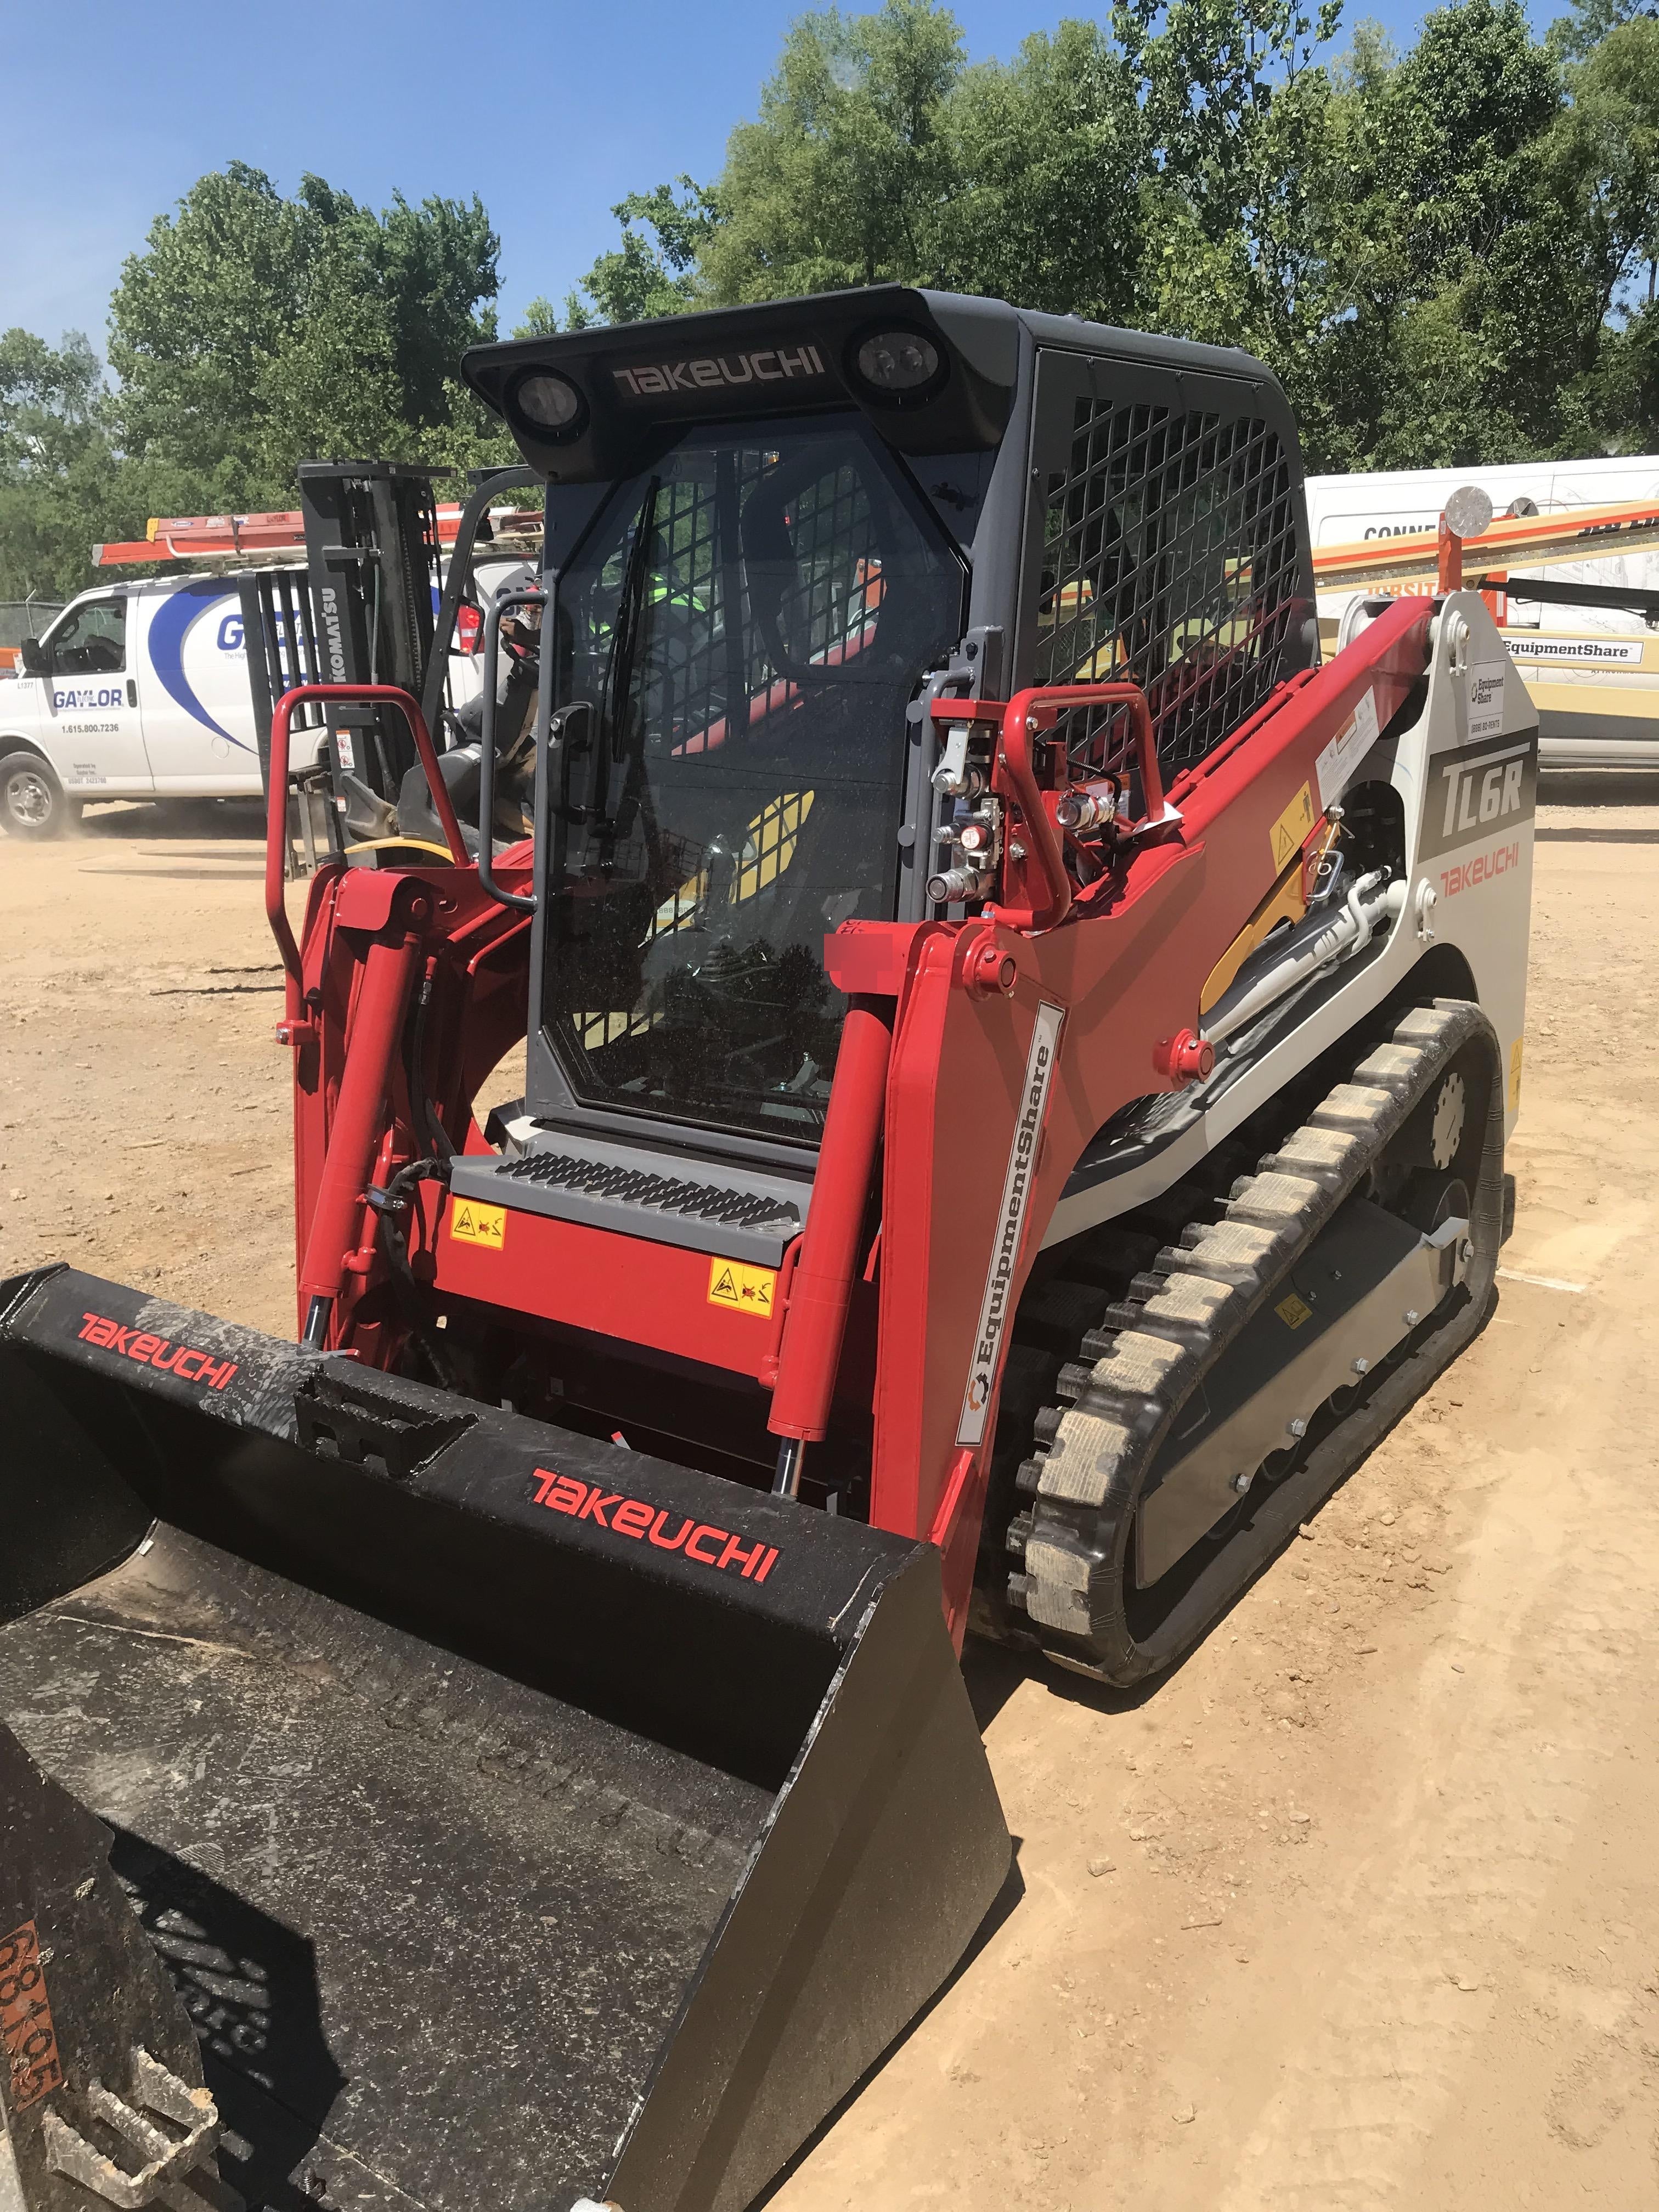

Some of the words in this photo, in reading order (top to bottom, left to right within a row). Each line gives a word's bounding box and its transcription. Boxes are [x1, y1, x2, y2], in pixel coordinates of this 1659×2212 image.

[612, 346, 825, 394] TAKEUCHI
[321, 588, 346, 682] KOMATSU
[1503, 641, 1629, 658] EquipmentShare
[53, 689, 122, 708] GAYLOR
[1477, 692, 1492, 704] Share
[1478, 676, 1504, 692] Equipment
[61, 724, 119, 733] 1.615.800.7236
[1442, 742, 1530, 838] TL6R
[1440, 842, 1519, 897] TAKEUCHI
[977, 1045, 1050, 1365] EquipmentShare
[79, 1312, 238, 1390] TAKEUCHI
[533, 1468, 779, 1582] TAKEUCHI
